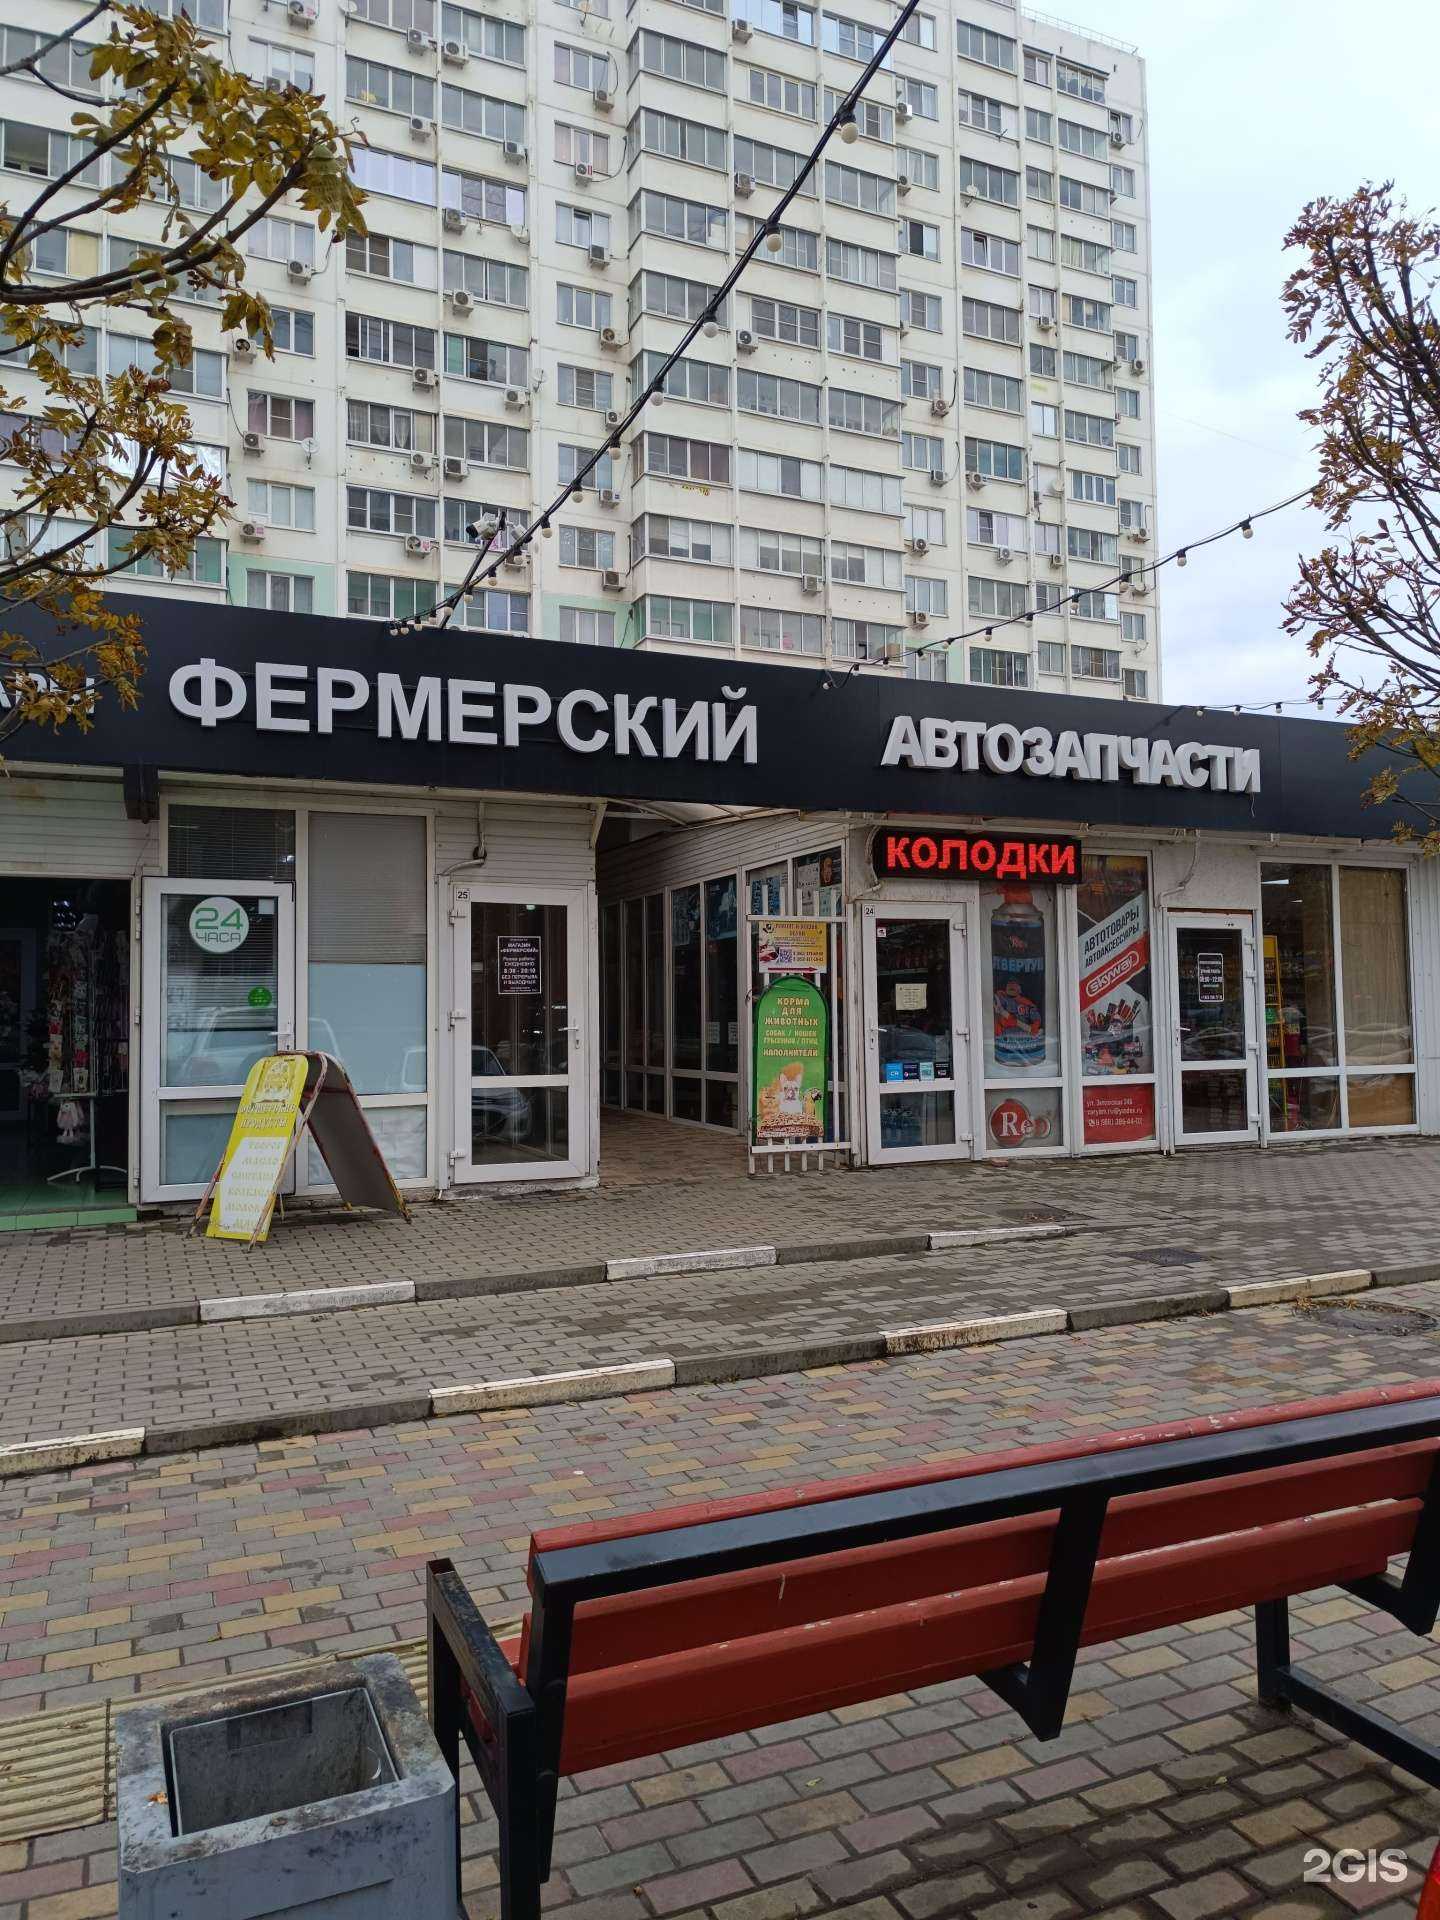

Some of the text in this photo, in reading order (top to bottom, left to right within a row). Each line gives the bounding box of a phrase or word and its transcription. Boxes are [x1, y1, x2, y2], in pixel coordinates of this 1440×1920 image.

[168, 658, 759, 765] ФЕРМЕРСКИЙ
[881, 715, 1261, 793] АВТОЗАПЧАСТИ
[886, 836, 1076, 880] КОЛОДКИ
[457, 891, 468, 899] 25
[866, 907, 874, 915] 24
[195, 907, 243, 930] 24
[1084, 905, 1140, 954] АВТОТОВАРЫ
[195, 932, 241, 943] ЧАСА
[1089, 955, 1133, 992] skyway
[777, 997, 810, 1007] КОРМА
[781, 1007, 802, 1017] ДЛЯ
[764, 1016, 819, 1026] ЖИВОТНЫХ
[763, 1048, 819, 1057] НАПОЛНИТЕЛИ
